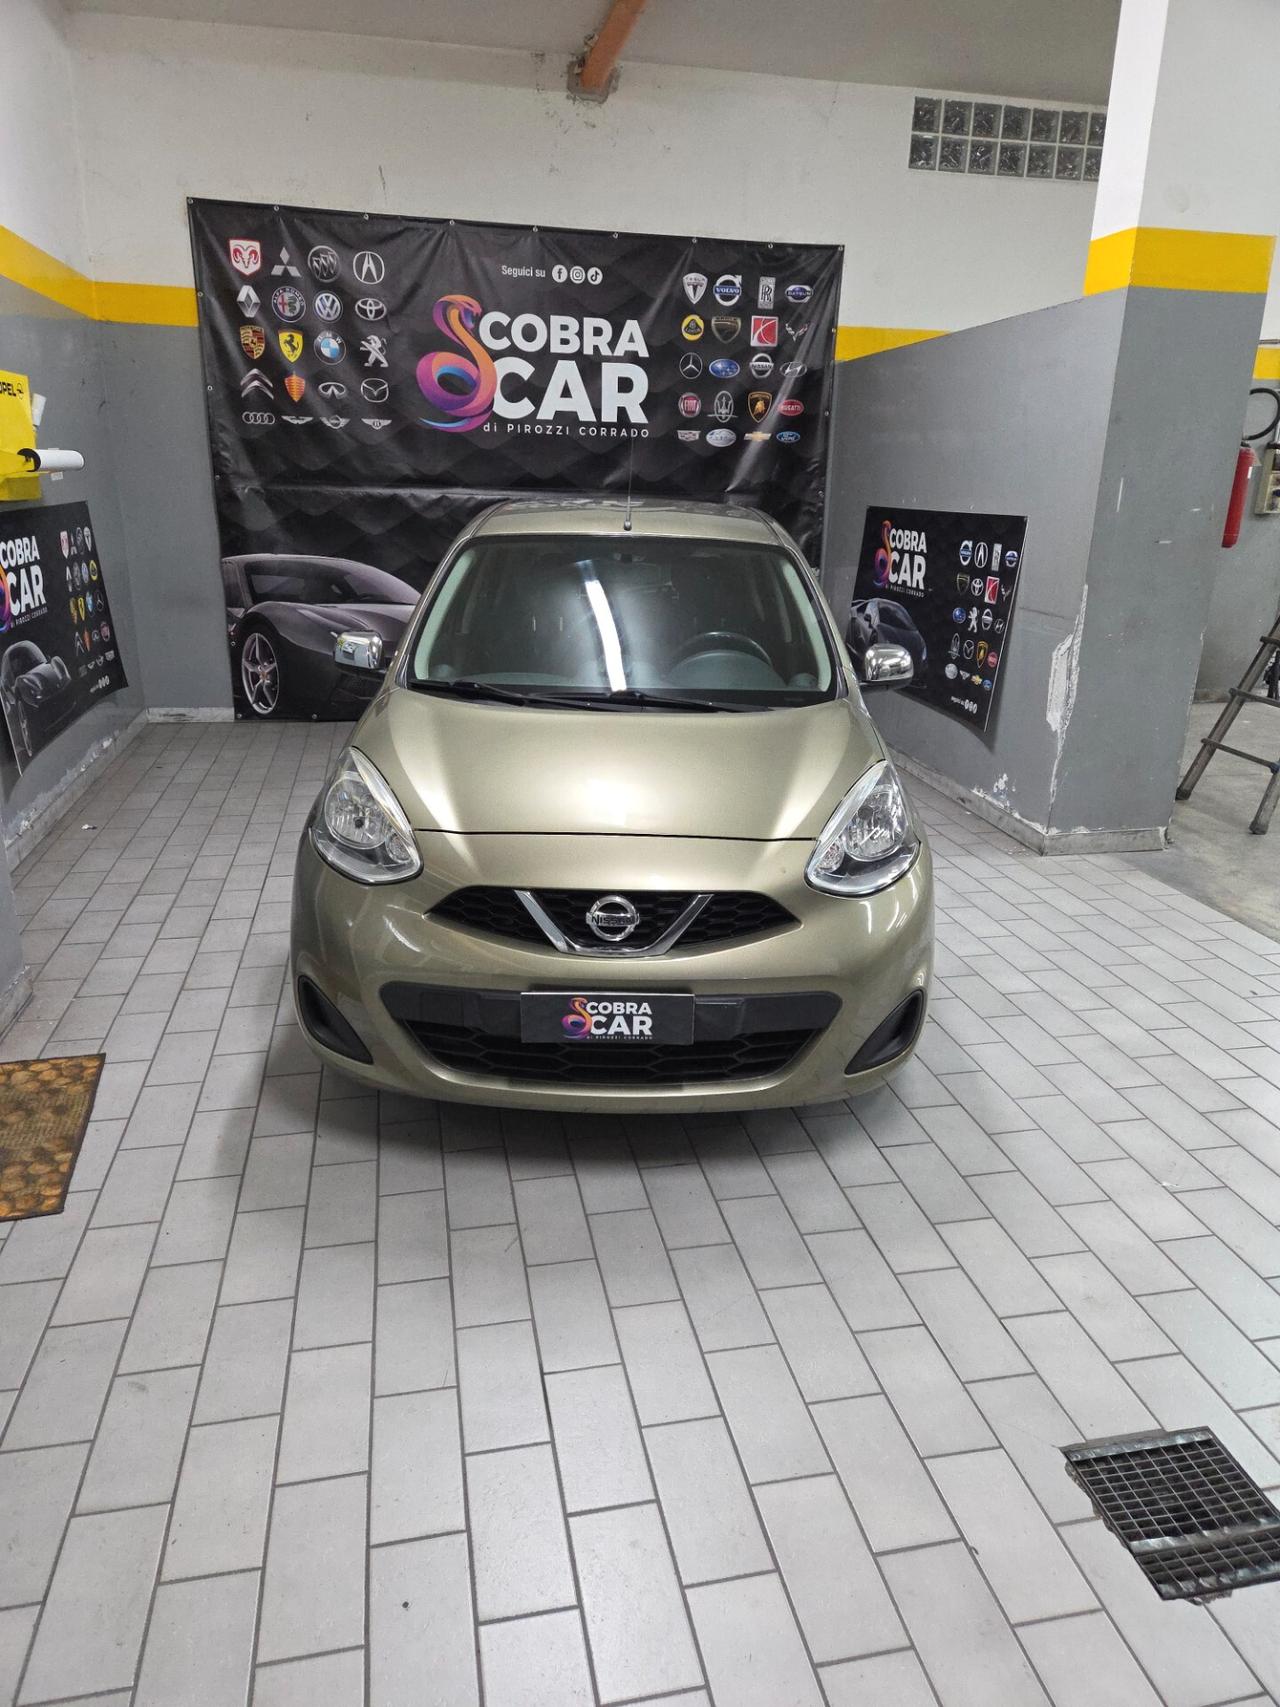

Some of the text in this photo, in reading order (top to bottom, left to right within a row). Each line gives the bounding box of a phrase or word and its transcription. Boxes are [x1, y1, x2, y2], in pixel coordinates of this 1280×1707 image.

[501, 264, 546, 278] Seguici su
[479, 311, 650, 358] COBRA
[493, 356, 649, 424] CAR
[483, 422, 649, 438] di PIROZZI CORRADO
[0, 535, 40, 570] COBRA
[889, 528, 927, 553] COBRA
[888, 551, 925, 590] CAR
[7, 564, 47, 616] CAR
[586, 1002, 653, 1015] COBRA
[590, 1015, 653, 1036] CAR
